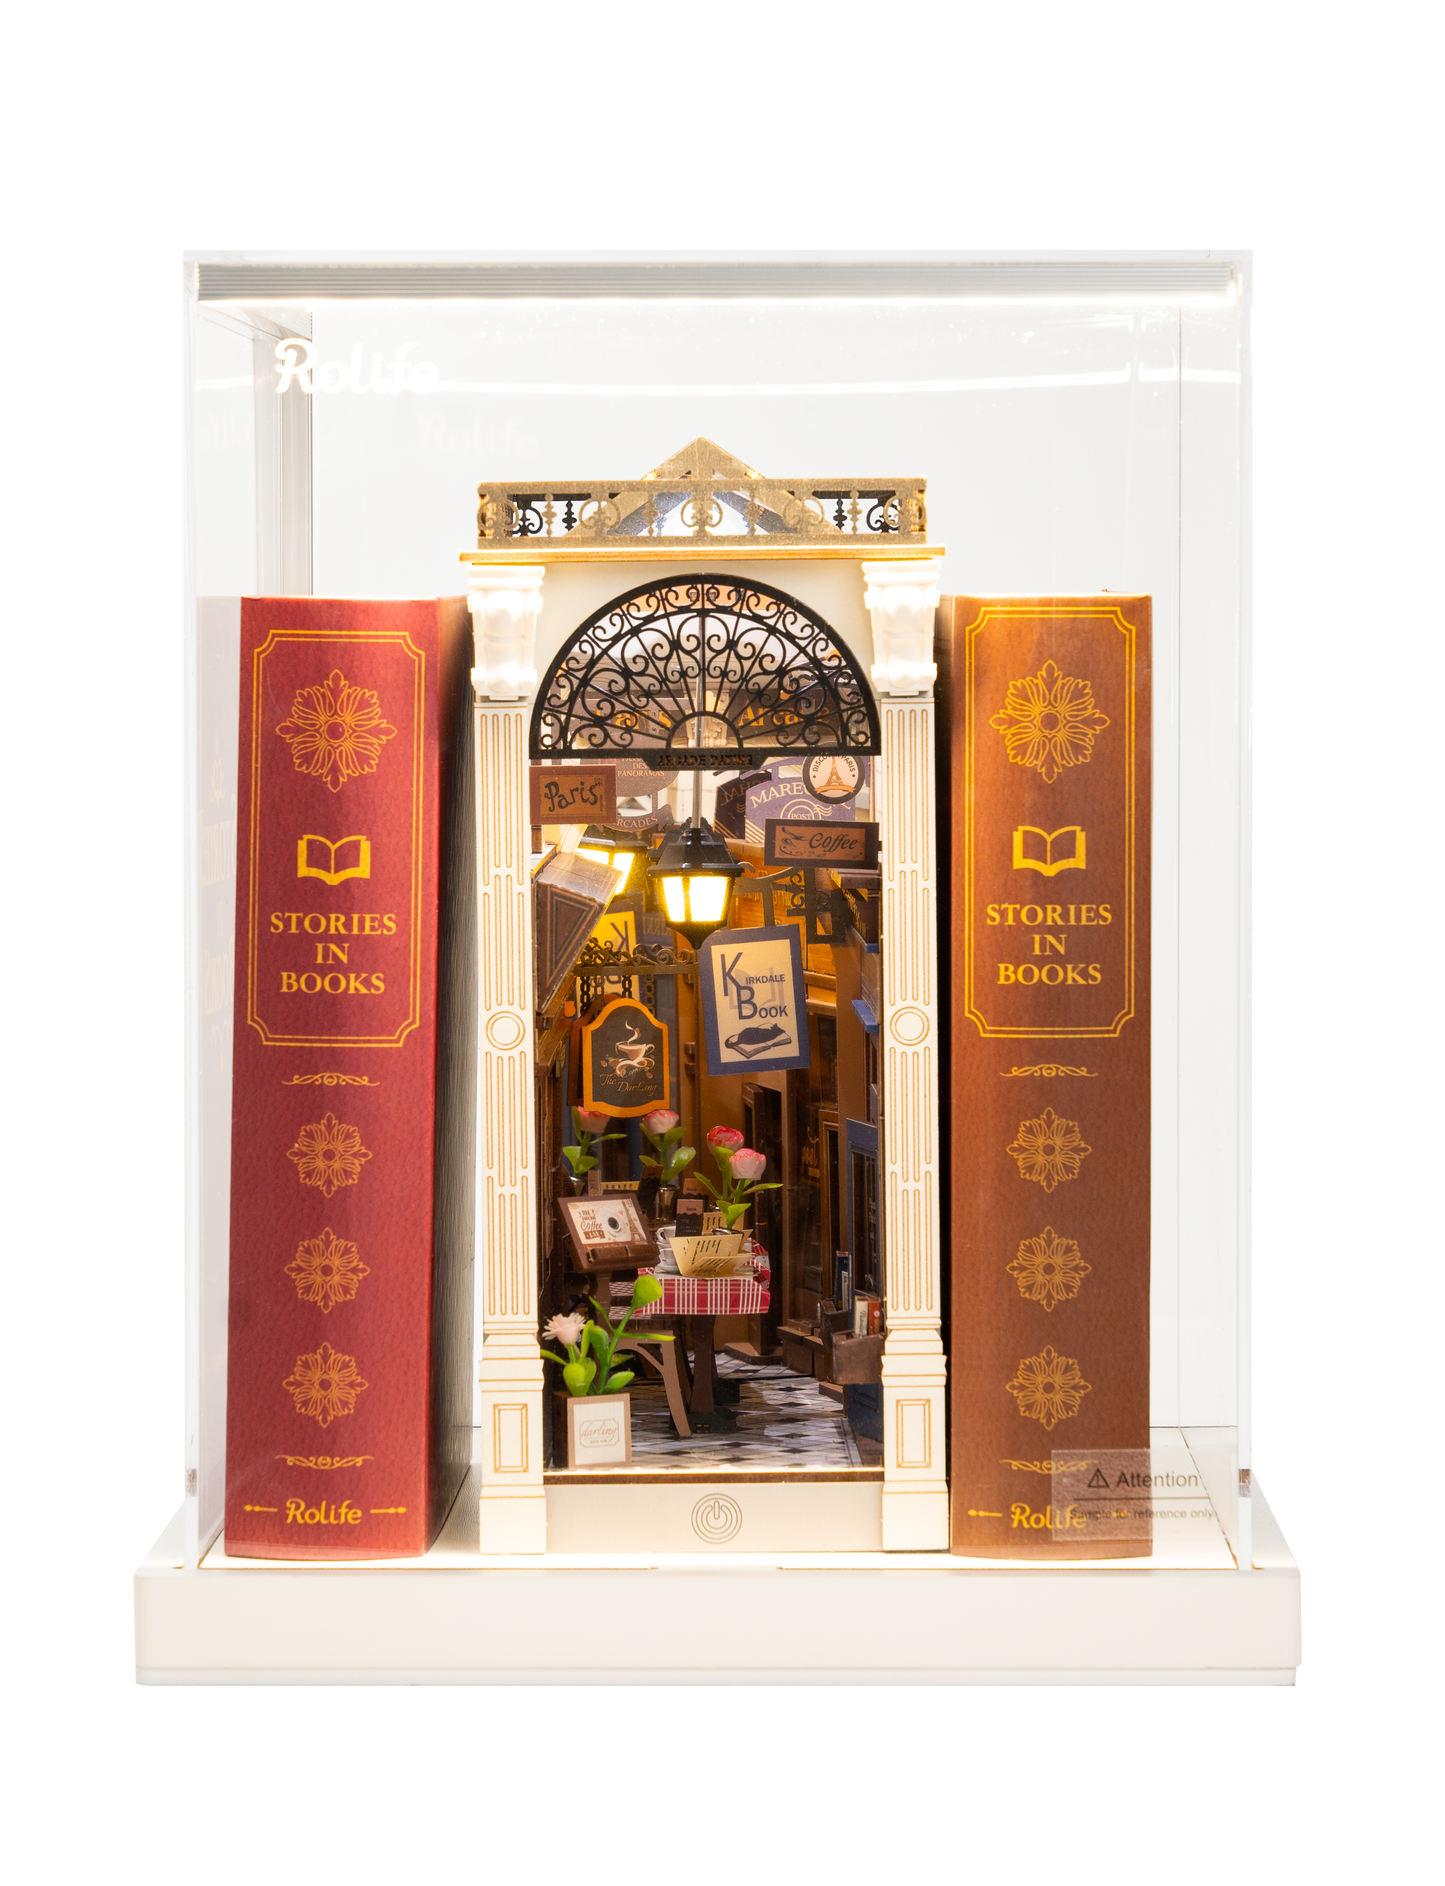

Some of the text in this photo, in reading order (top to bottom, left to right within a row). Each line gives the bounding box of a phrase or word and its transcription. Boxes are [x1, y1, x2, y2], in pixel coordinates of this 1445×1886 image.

[275, 337, 440, 395] Rolife
[632, 762, 647, 770] DES
[656, 754, 706, 767] ARCADE
[544, 781, 599, 813] Paris
[616, 815, 658, 829] RCADES
[809, 832, 858, 853] Coffee
[270, 912, 397, 935] STORIES
[986, 904, 1113, 926] STORIES
[315, 943, 350, 964] IN
[1032, 934, 1068, 956] IN
[280, 972, 386, 995] BOOKS
[997, 963, 1102, 986] BOOKS
[600, 1073, 617, 1086] The
[580, 1220, 603, 1231] Coffee
[581, 1421, 617, 1442] darling
[1116, 1472, 1198, 1488] Attention
[286, 1497, 362, 1525] Rolife
[1010, 1502, 1087, 1529] Rolife
[1070, 1508, 1112, 1521] Sample
[1133, 1508, 1188, 1519] reference
